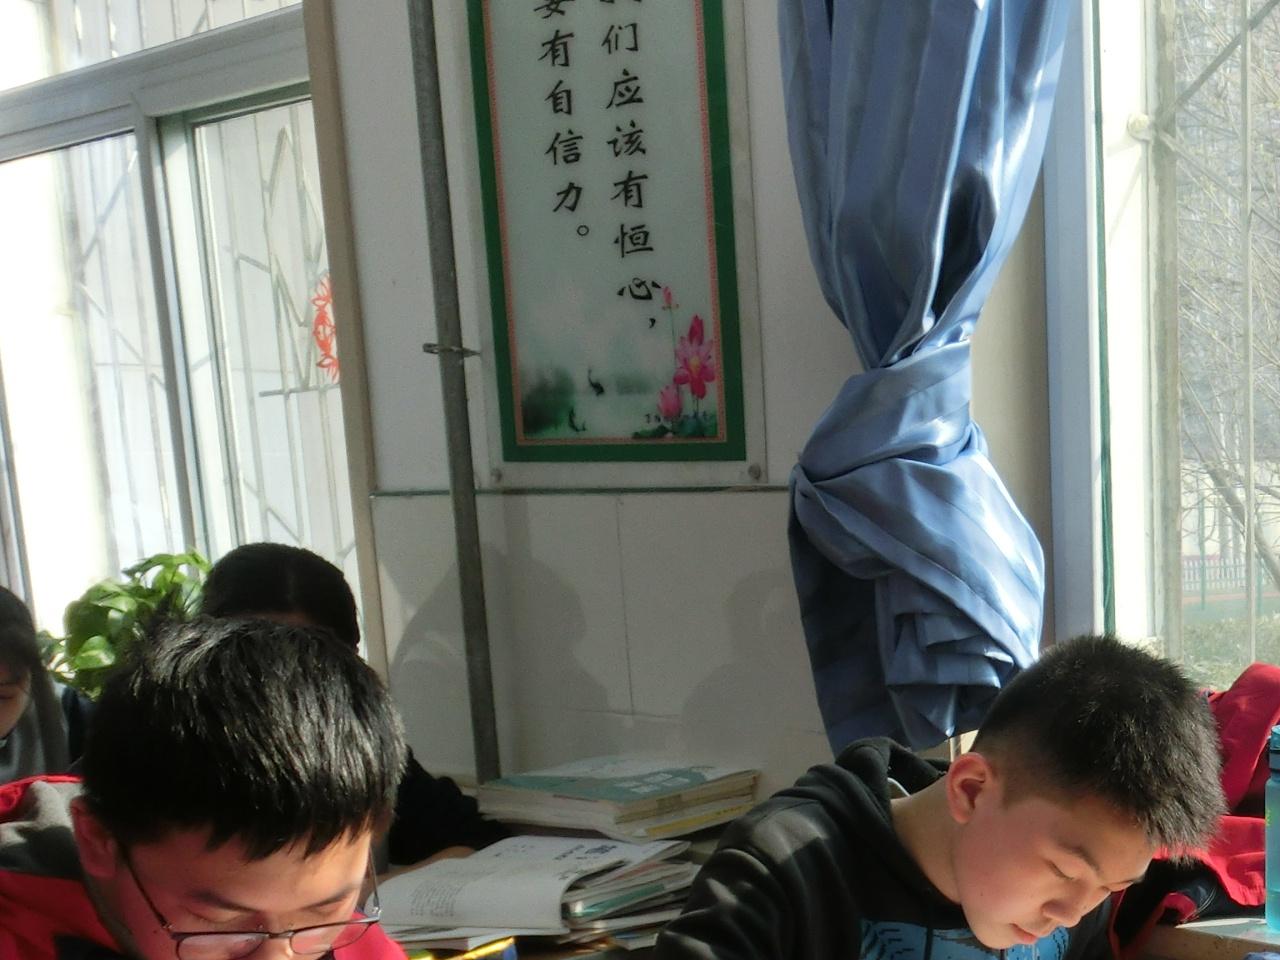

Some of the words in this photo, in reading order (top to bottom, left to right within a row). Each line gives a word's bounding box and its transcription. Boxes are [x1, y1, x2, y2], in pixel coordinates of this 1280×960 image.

[601, 0, 661, 329] 们应该有恒心，
